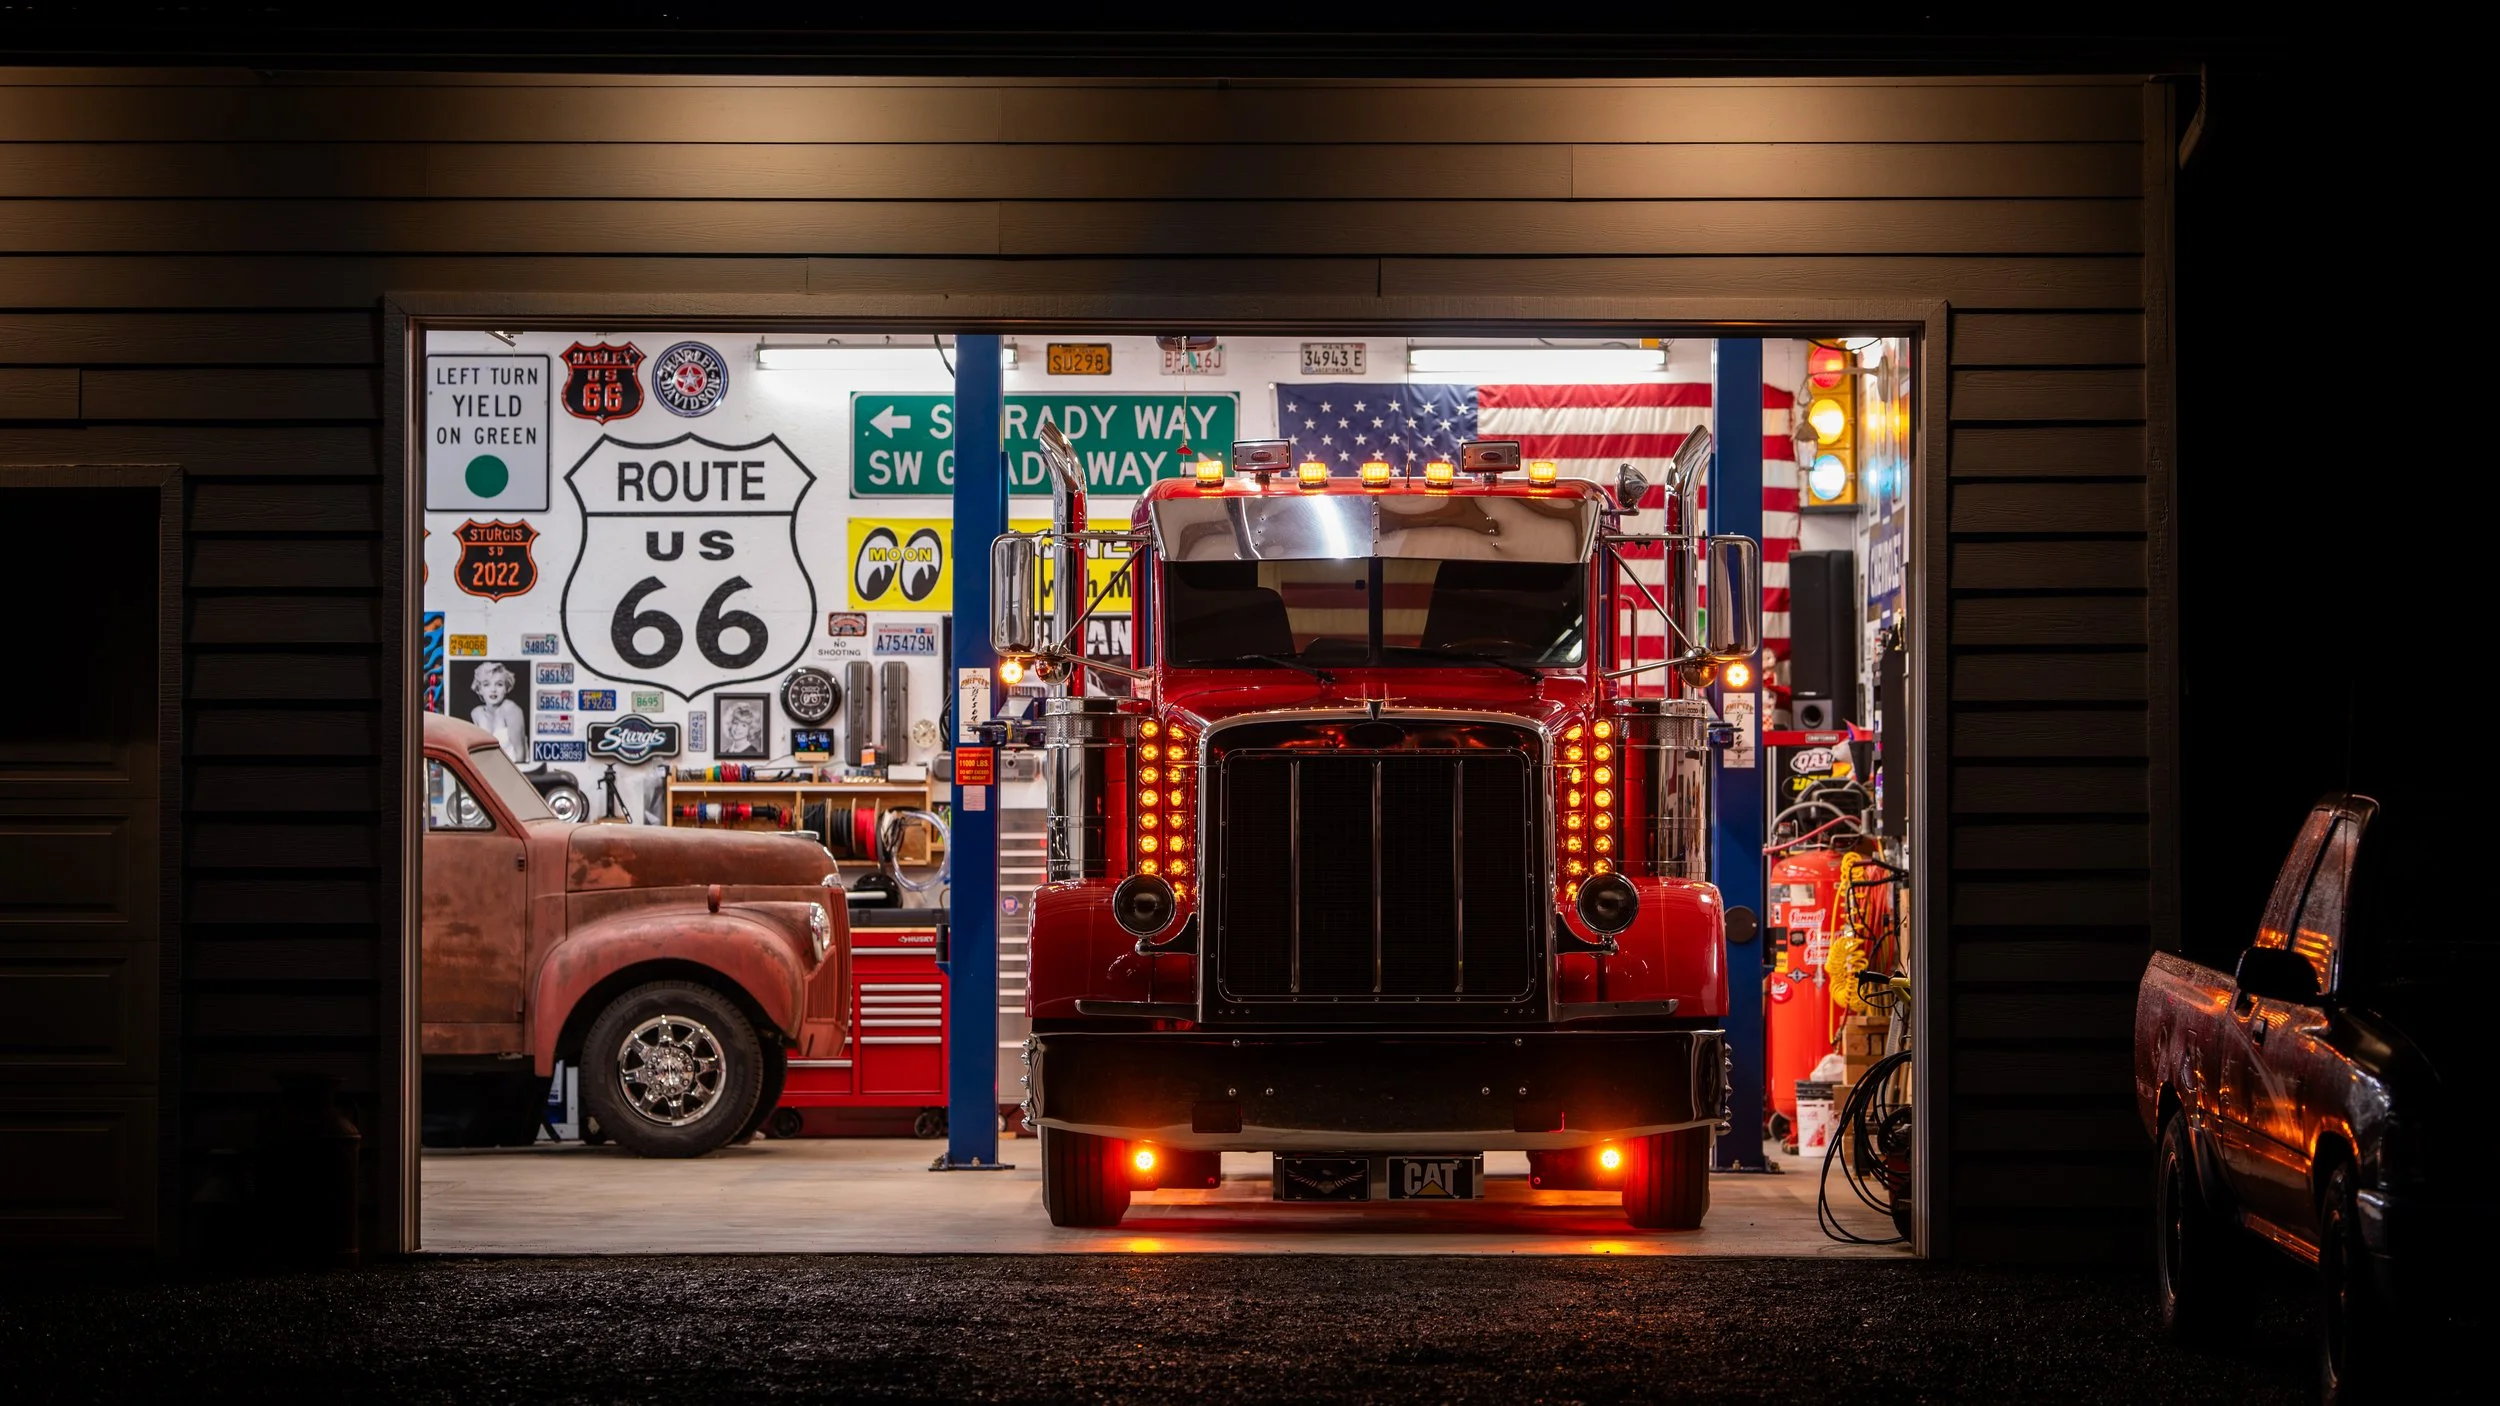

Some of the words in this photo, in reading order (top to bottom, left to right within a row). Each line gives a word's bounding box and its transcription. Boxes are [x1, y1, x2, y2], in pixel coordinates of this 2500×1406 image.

[572, 351, 633, 365] HARLEY
[663, 349, 718, 375] HARLEY
[1053, 354, 1103, 371] SU298
[1304, 350, 1348, 367] 34943
[1354, 350, 1362, 367] E
[437, 367, 480, 385] LEFT
[490, 367, 538, 385] TURN
[587, 369, 617, 381] US
[583, 383, 623, 412] 66
[661, 378, 720, 410] DAVIDSON
[452, 394, 522, 417] YIELD
[1003, 404, 1118, 440] RADY
[1134, 404, 1218, 440] WAY
[437, 426, 460, 445] ON
[474, 426, 537, 445] GREEN
[868, 449, 923, 485] SW
[1086, 451, 1168, 486] WAY
[617, 460, 766, 502] ROUTE
[469, 528, 524, 542] STURGIS
[646, 529, 735, 561] US
[869, 547, 933, 563] MOON
[472, 562, 520, 587] 2022
[610, 575, 769, 669] 66
[834, 640, 846, 648] NO
[877, 635, 934, 651] A75479N
[597, 727, 667, 750] Sturgis
[534, 743, 560, 760] KCC
[959, 759, 975, 767] 11000
[1797, 752, 1830, 771] QA1
[1404, 1162, 1458, 1197] CAT
